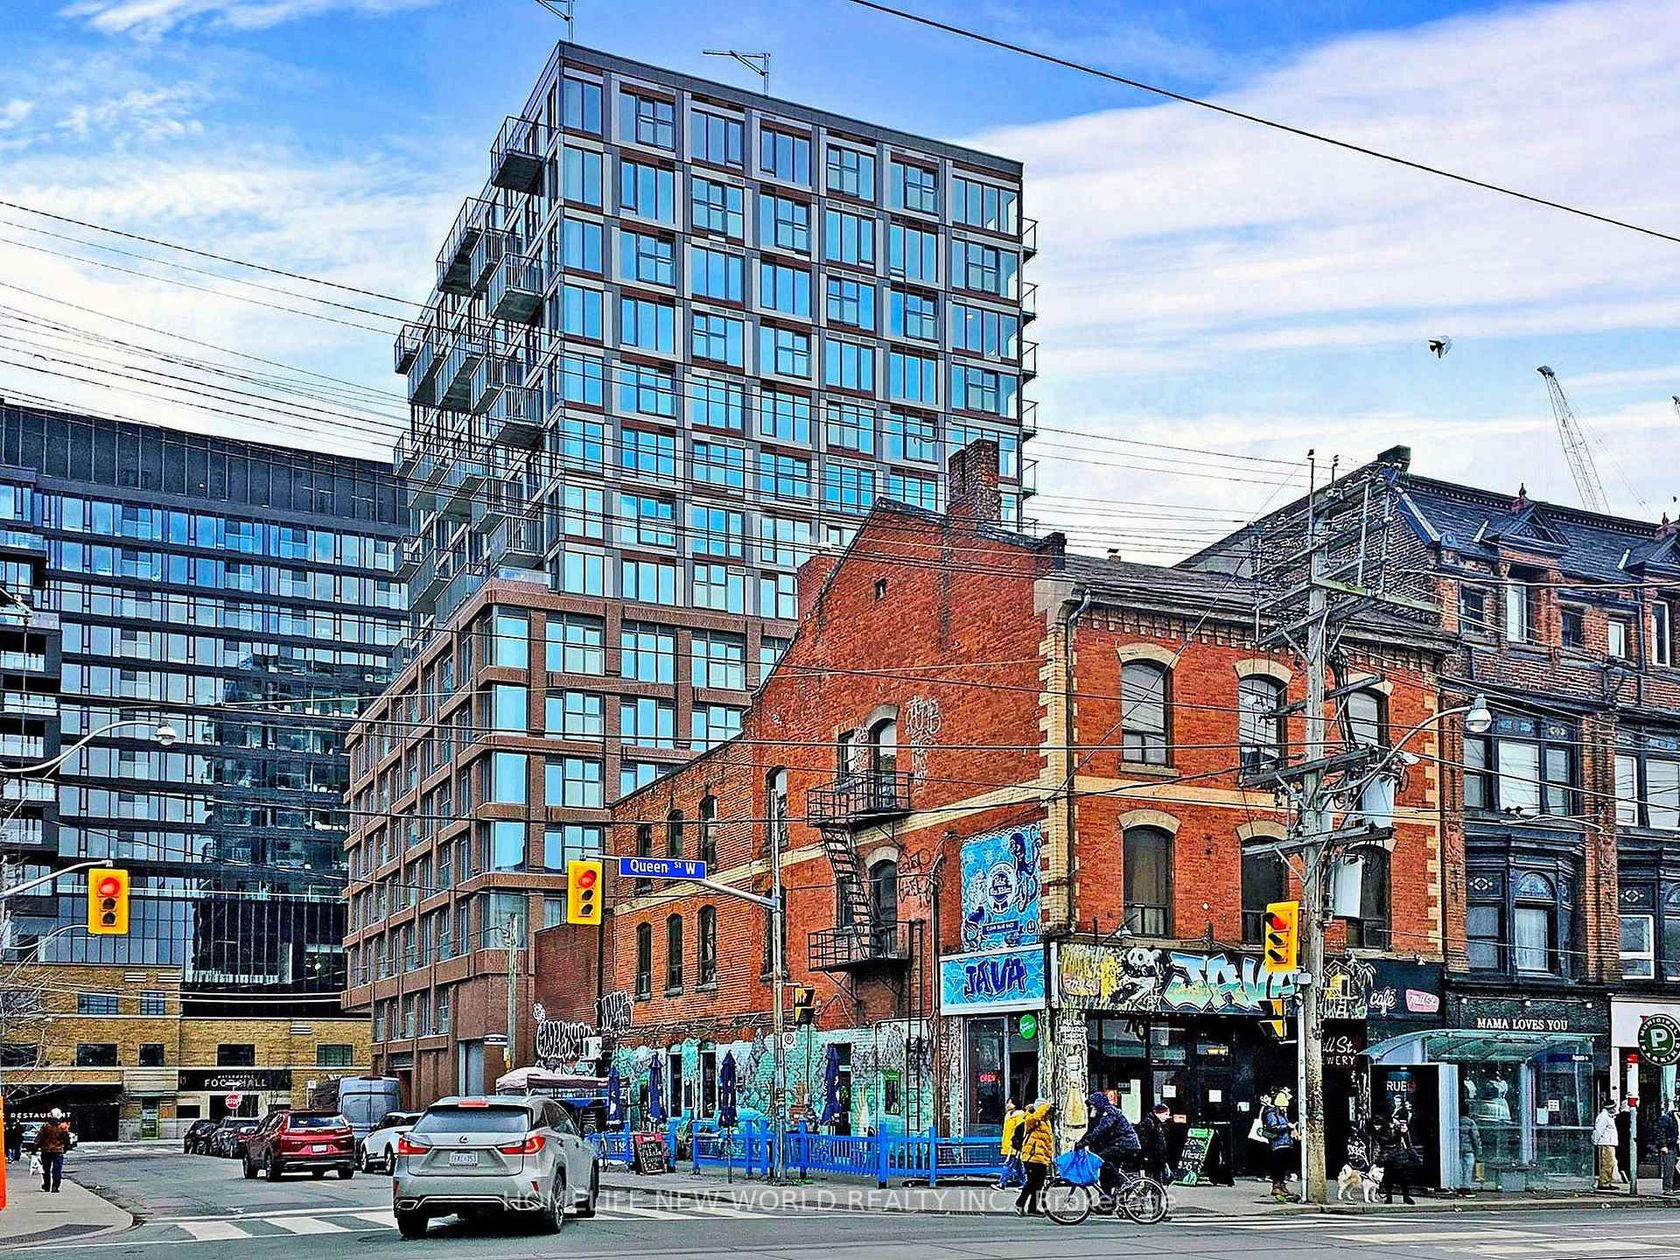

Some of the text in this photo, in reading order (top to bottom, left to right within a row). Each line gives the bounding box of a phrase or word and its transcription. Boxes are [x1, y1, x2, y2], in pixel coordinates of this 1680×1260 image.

[630, 859, 668, 874] Queen
[685, 862, 696, 875] W
[964, 956, 1027, 998] JAVA
[1369, 988, 1396, 1017] café
[1477, 1017, 1568, 1031] MAMA LOVES YOU
[1322, 1036, 1357, 1053] ill St.
[1651, 1029, 1668, 1047] P
[1326, 1056, 1355, 1065] WERY
